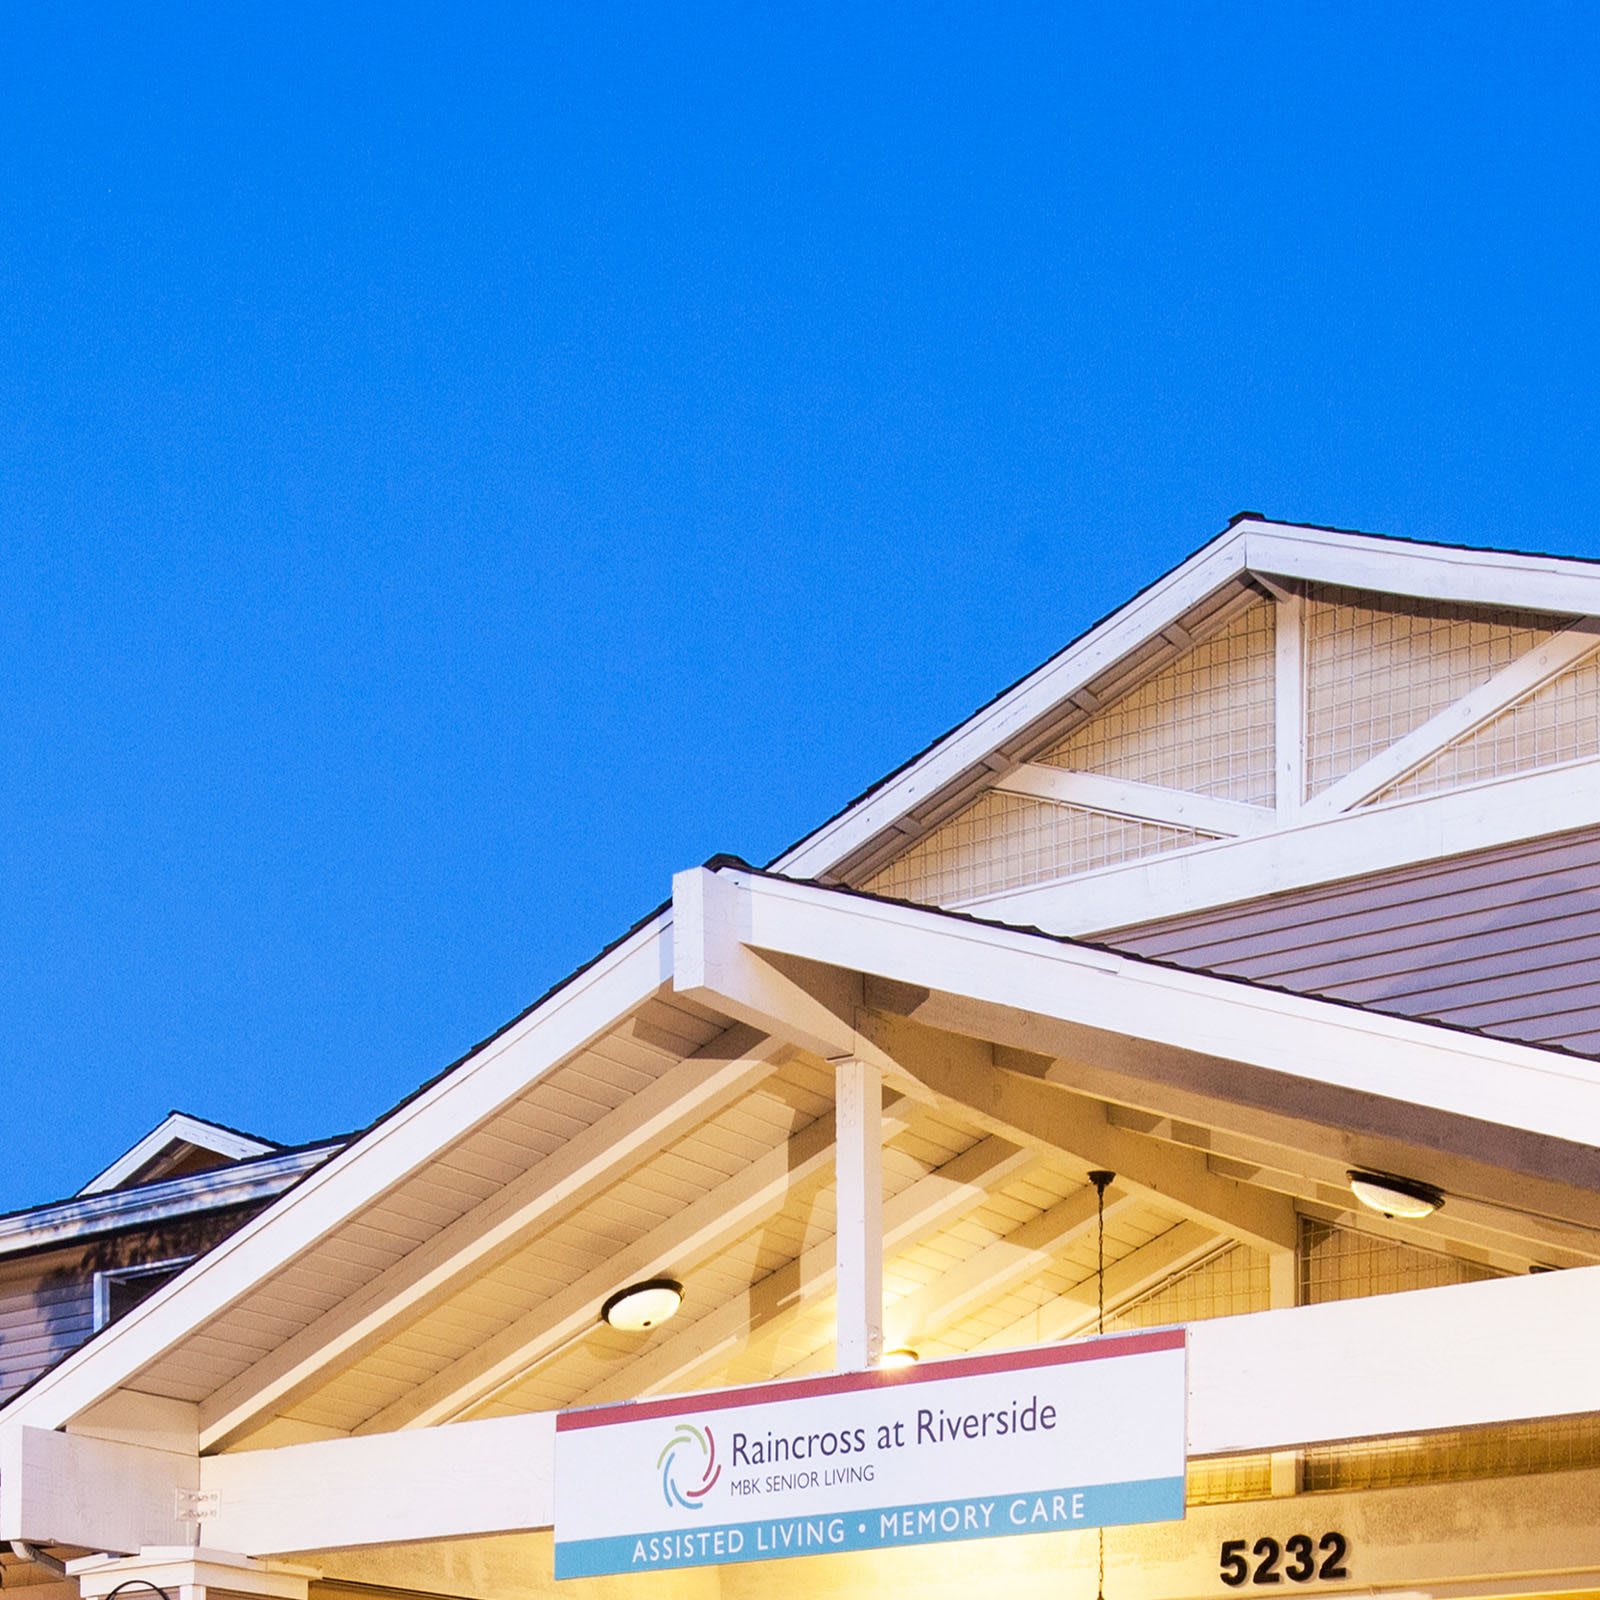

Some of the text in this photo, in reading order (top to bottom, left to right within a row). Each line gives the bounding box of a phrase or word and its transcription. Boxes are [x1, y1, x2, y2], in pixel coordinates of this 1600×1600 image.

[732, 1395, 1057, 1467] Raincross at Riverside
[730, 1464, 875, 1496] MBK SENIOR LIVING
[631, 1493, 1085, 1563] ASSISTED LIVING MEMORY CARE
[1219, 1531, 1348, 1586] 5232
